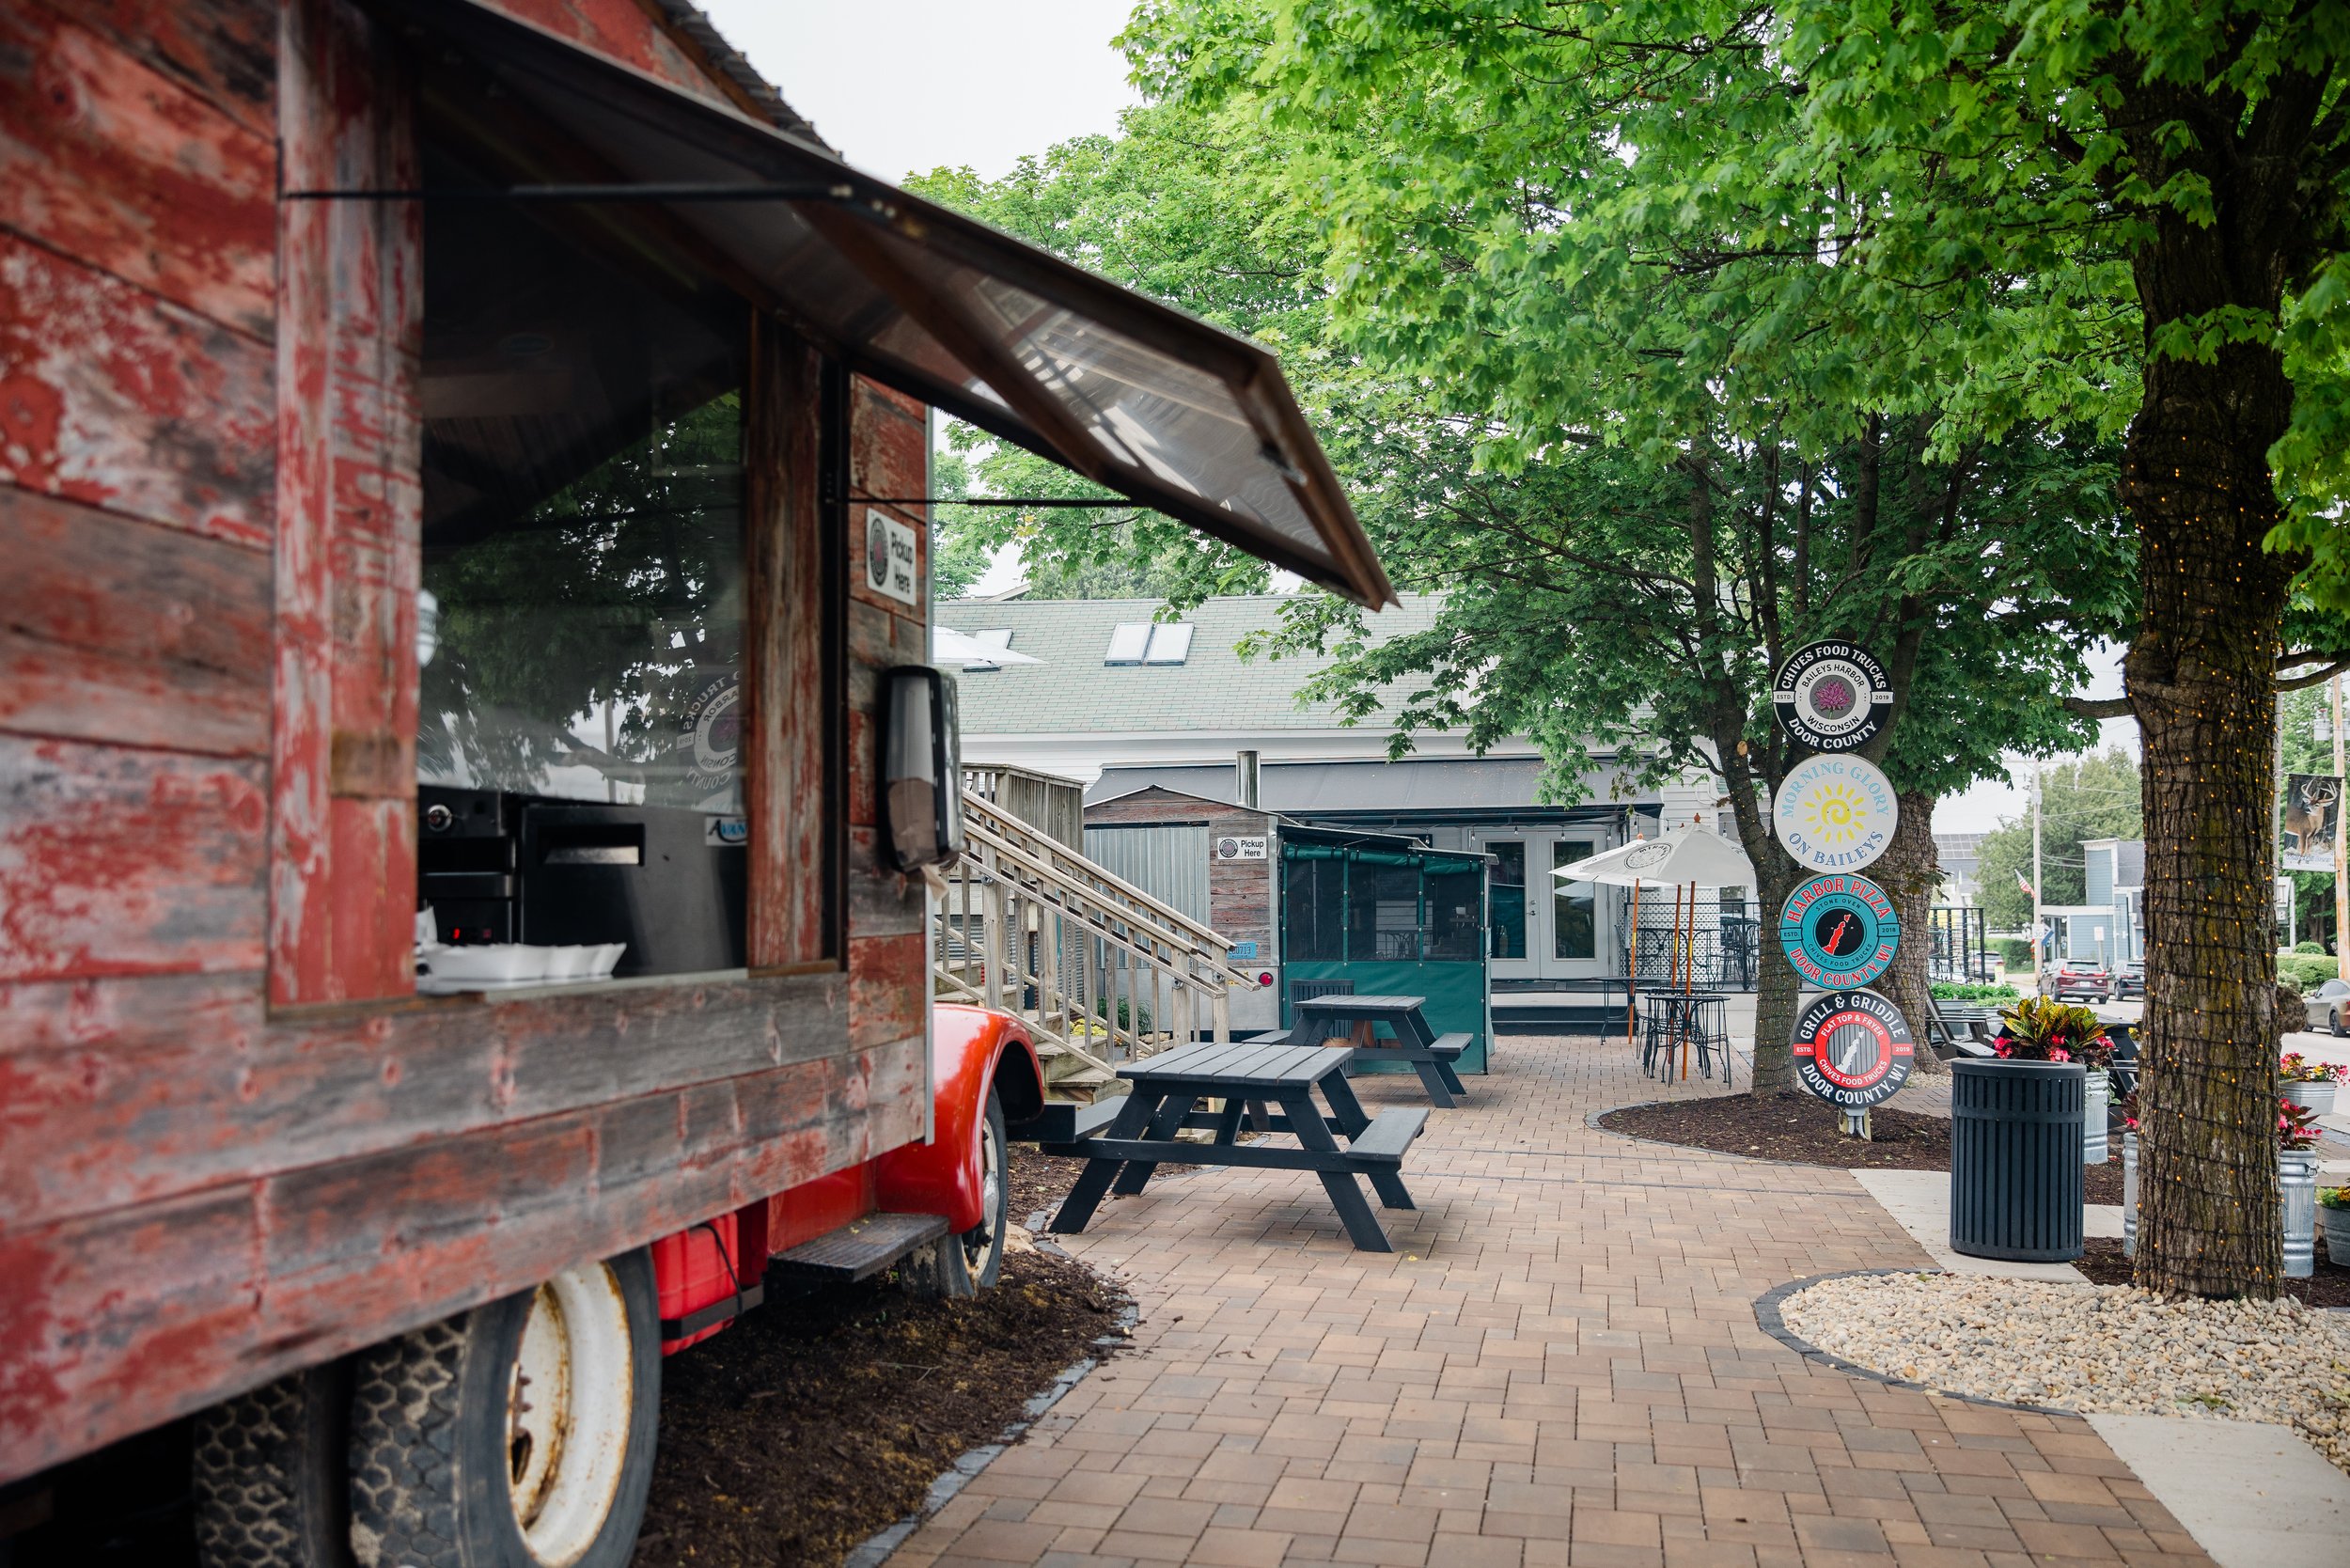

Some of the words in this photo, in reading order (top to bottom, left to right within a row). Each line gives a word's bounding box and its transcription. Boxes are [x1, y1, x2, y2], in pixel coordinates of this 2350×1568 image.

[890, 531, 913, 569] Pickup
[894, 565, 911, 594] Here
[1781, 651, 1814, 689] CHIVES
[1815, 645, 1849, 658] FOOD
[1852, 649, 1887, 689] TRUCKS
[1801, 664, 1832, 687] BAILEYS
[1834, 664, 1864, 687] HARBOR
[1788, 717, 1820, 748] DOOR
[1823, 720, 1877, 749] COUNTY
[1807, 714, 1860, 732] WISCONSIN
[1782, 761, 1844, 818] MORNING
[1849, 766, 1889, 817] GLORY
[708, 819, 748, 840] AVAN
[1241, 840, 1264, 849] Pickup
[1789, 832, 1811, 855] ON
[1812, 831, 1884, 866] BAILEYS
[1786, 878, 1844, 923] HARBOR
[1850, 880, 1892, 919] PIZZA
[1815, 899, 1839, 911] STONE
[1842, 898, 1861, 909] OVEN
[1790, 948, 1822, 980] DOOR
[1875, 944, 1893, 963] WI
[1808, 944, 1827, 963] CHIVES
[1852, 944, 1872, 964] TRUCKS
[1800, 1002, 1833, 1040] GRILL
[1834, 994, 1845, 1009] &
[1851, 995, 1906, 1038] GRIDDLE
[1820, 1018, 1837, 1037] FLAT
[1836, 1014, 1853, 1024] TOP
[1862, 1017, 1884, 1037] FRYER
[1802, 1063, 1834, 1098] DOOR
[1835, 1079, 1895, 1105] COUNTY,
[1888, 1063, 1906, 1082] WI
[1819, 1058, 1841, 1081] CHIVES
[1841, 1076, 1863, 1086] FOOD
[1864, 1059, 1888, 1083] TRUCKS
